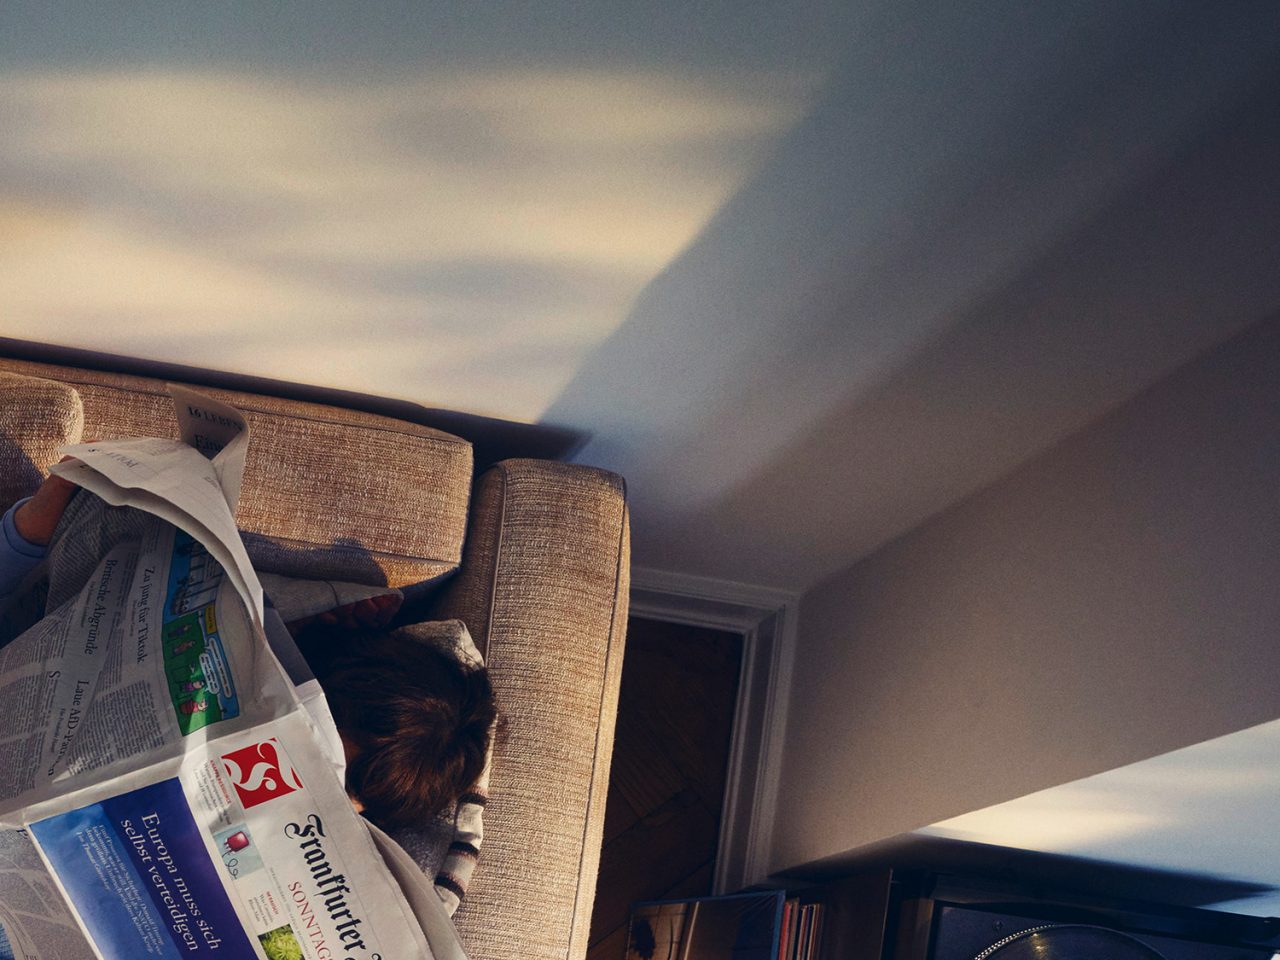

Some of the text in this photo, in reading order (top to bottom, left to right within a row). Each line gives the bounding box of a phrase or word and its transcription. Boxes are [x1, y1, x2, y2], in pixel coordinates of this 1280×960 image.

[85, 556, 116, 657] Britische Abgründe
[135, 565, 154, 665] Zu jung für Tiktok
[123, 820, 198, 950] selbst verteidigen
[142, 812, 221, 949] Europa muss sich
[284, 814, 366, 960] Frankfurter
